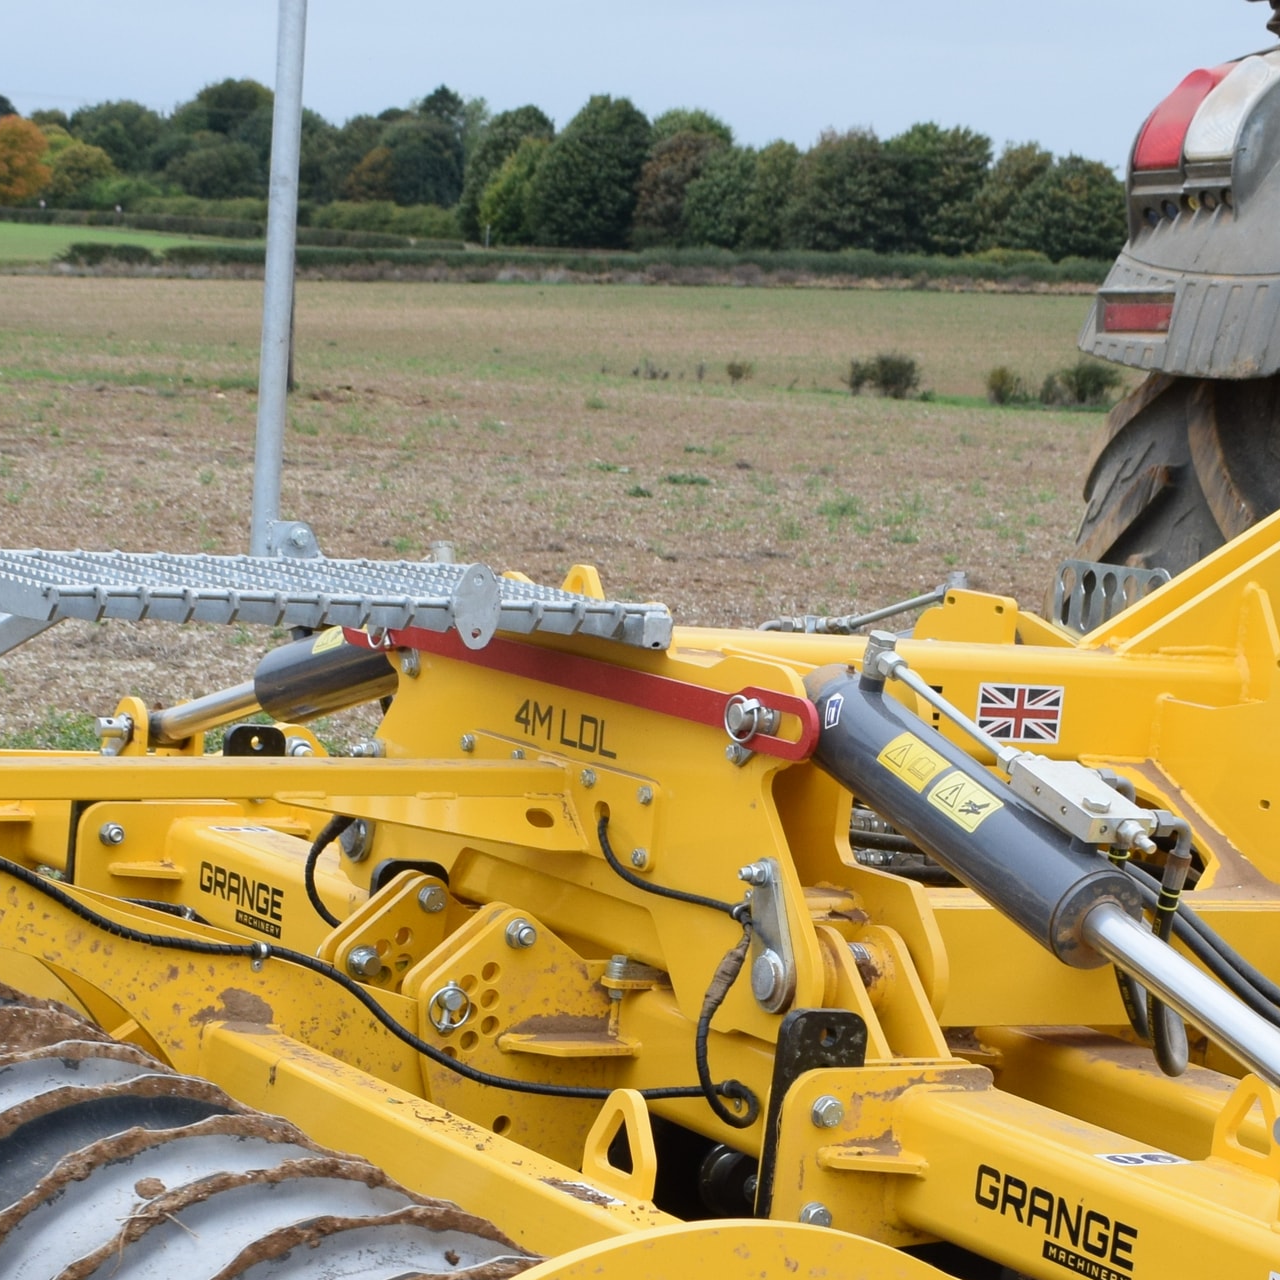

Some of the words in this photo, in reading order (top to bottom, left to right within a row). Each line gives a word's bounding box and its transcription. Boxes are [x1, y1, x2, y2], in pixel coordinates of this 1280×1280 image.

[514, 698, 553, 741] 4M
[560, 708, 617, 760] LDL
[200, 861, 284, 922] GRANGE
[237, 911, 280, 937] MACHINERY
[975, 1164, 1138, 1272] GRANGE
